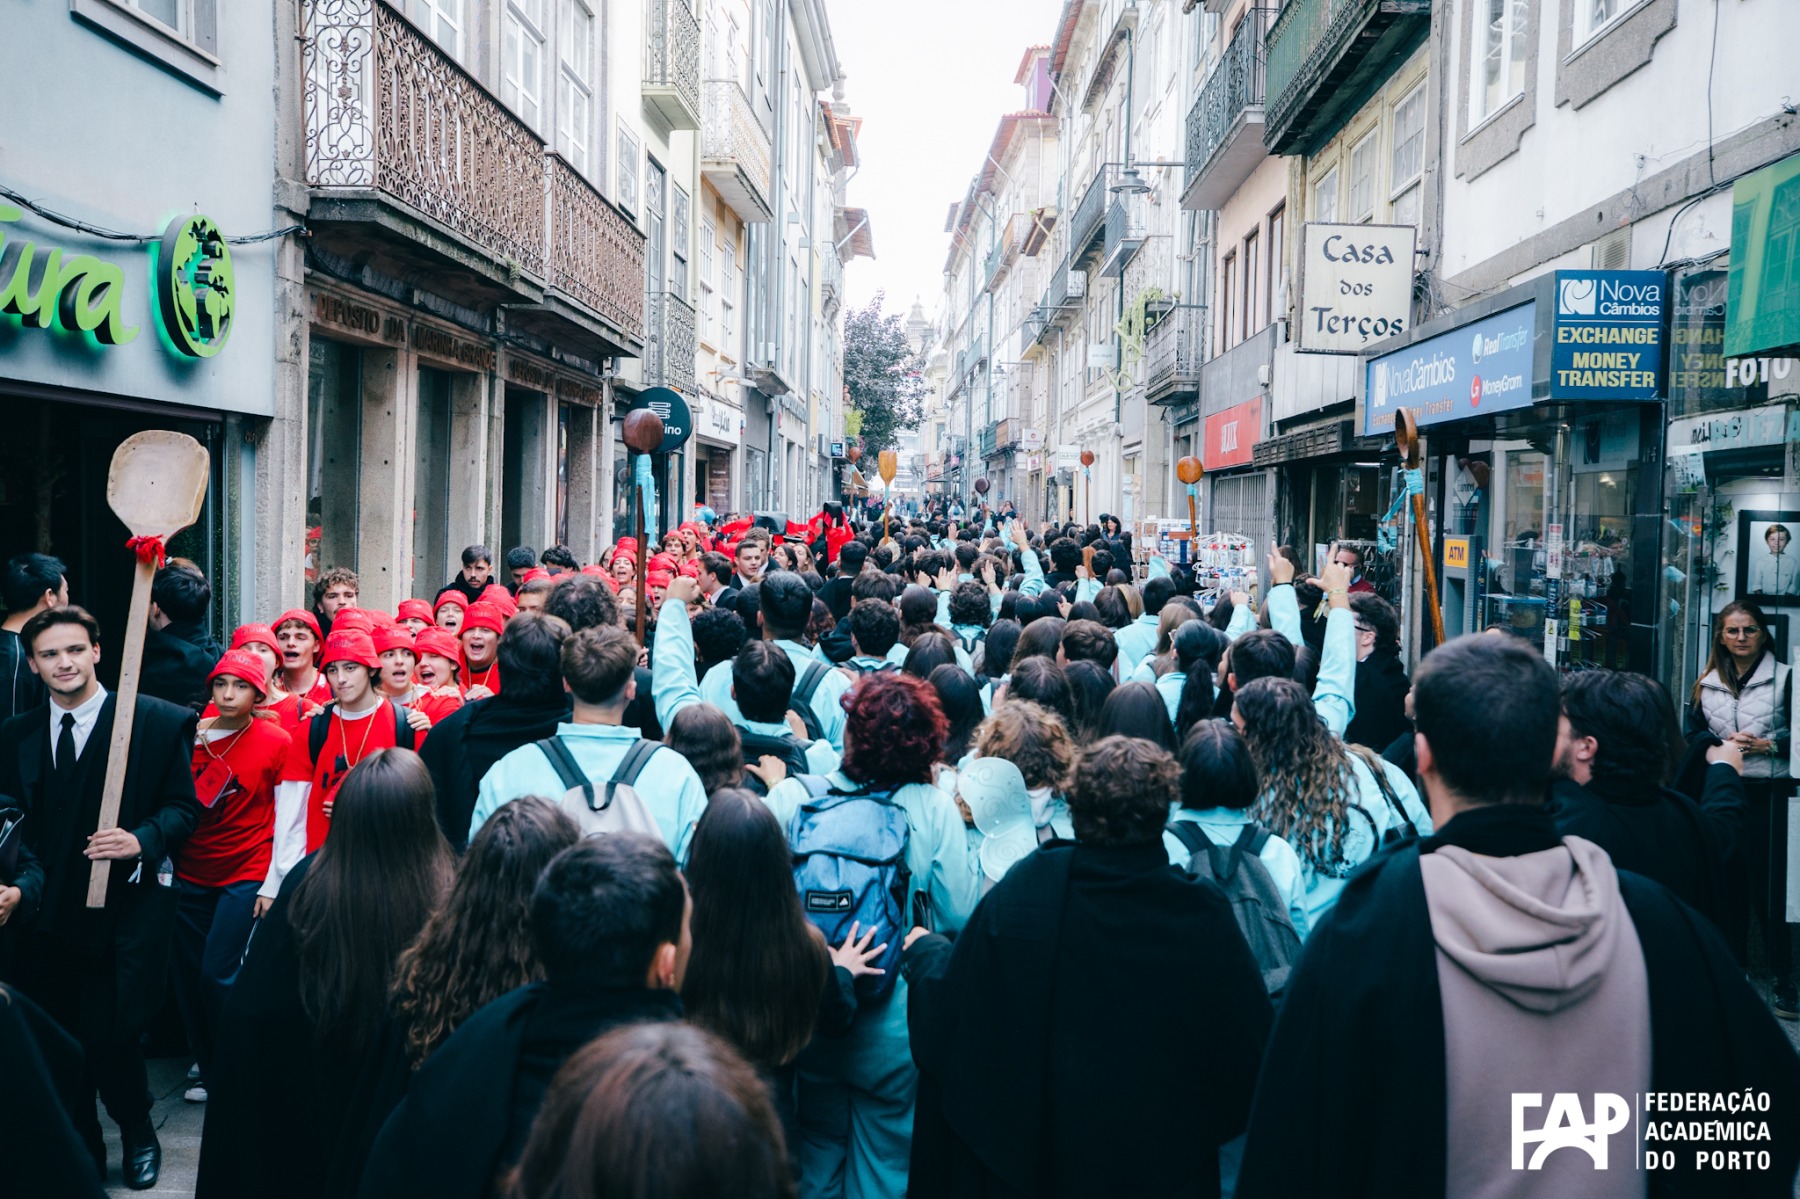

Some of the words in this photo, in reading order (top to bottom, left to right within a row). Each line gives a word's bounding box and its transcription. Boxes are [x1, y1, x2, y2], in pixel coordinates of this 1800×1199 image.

[1323, 235, 1394, 265] Casa
[1340, 279, 1373, 296] dos
[1600, 279, 1660, 301] Nova
[1600, 302, 1660, 316] Câmbios
[1310, 306, 1403, 343] Terços
[1557, 327, 1659, 344] EXCHANGE
[1572, 352, 1641, 369] MONEY
[1557, 370, 1655, 388] TRANSFER
[1726, 357, 1792, 389] FOTO
[1482, 374, 1522, 397] MoneyGram
[1425, 397, 1454, 417] Transfer
[1449, 546, 1464, 561] ATM
